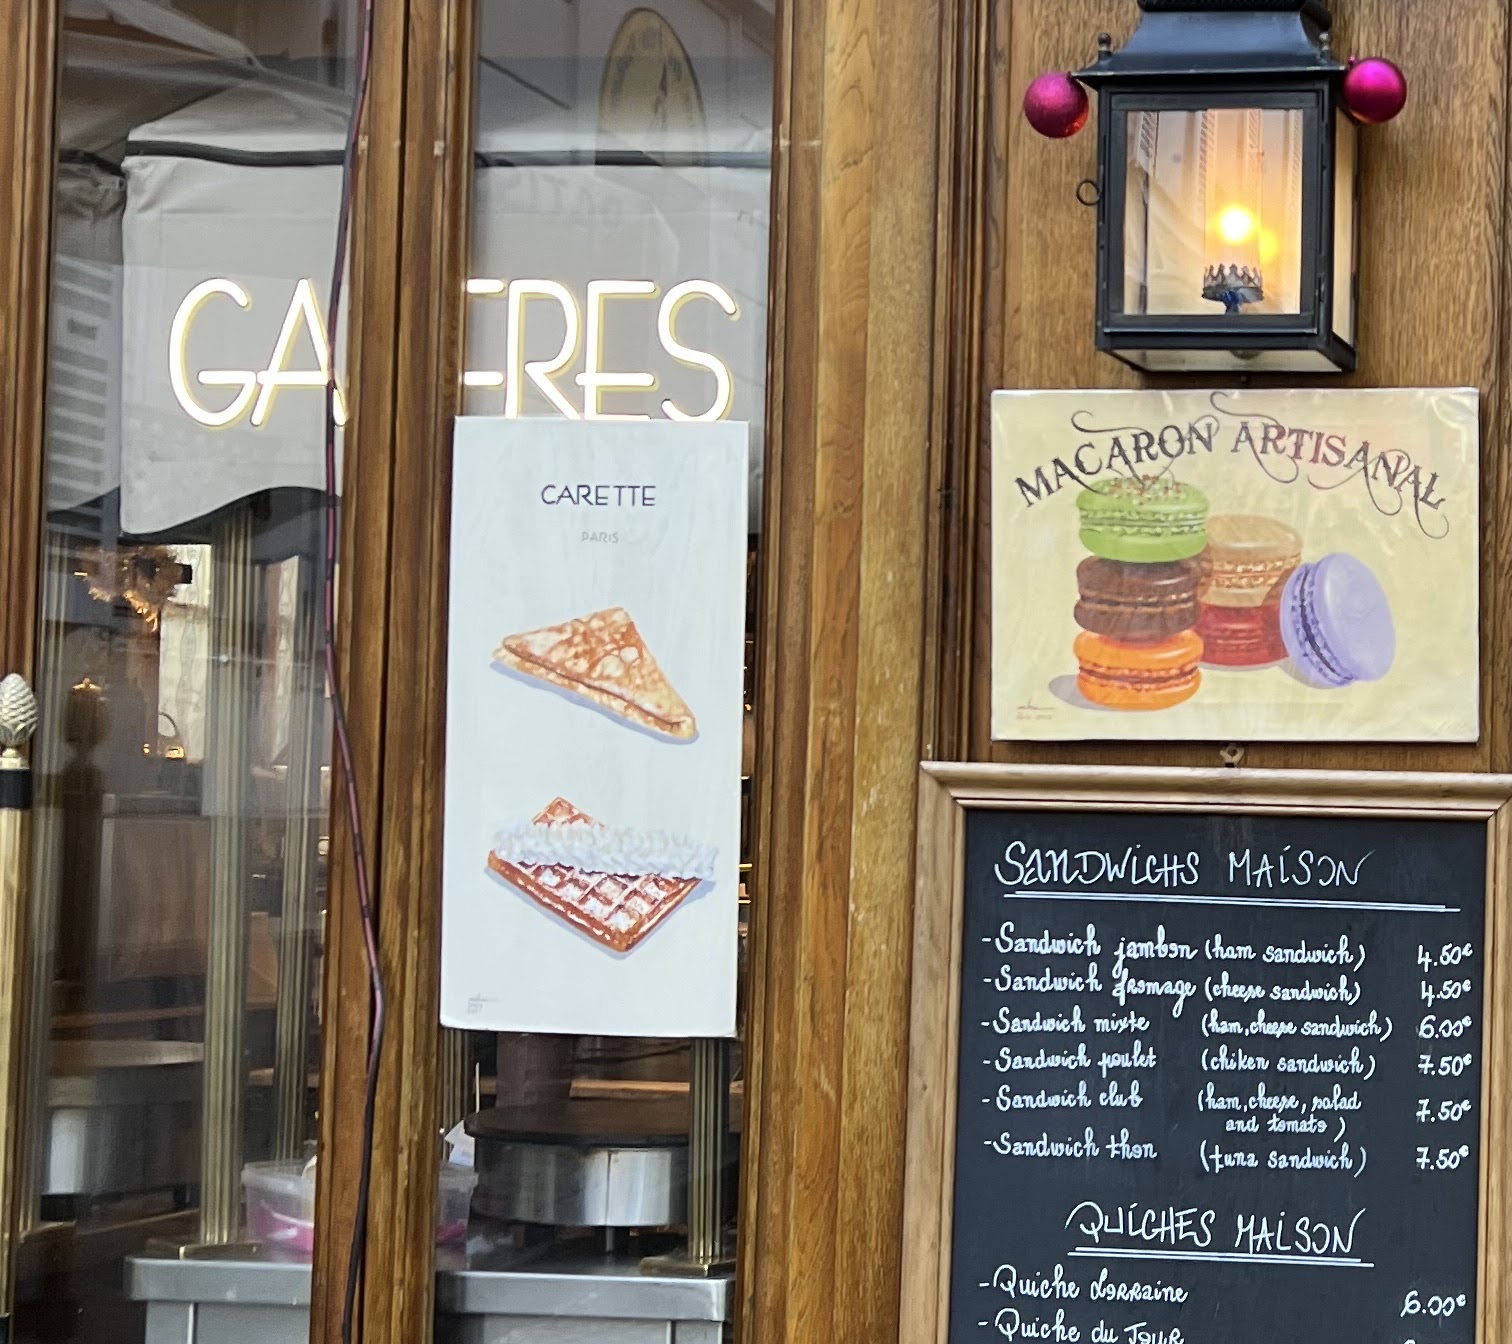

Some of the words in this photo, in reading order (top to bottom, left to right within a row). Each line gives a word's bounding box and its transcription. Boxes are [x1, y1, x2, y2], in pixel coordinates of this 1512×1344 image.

[1014, 409, 1220, 508] MACARON
[1210, 391, 1449, 540] ARTISANAL
[541, 484, 656, 507] CARETTE
[581, 531, 620, 544] PARIS
[994, 840, 1200, 888] SANDWICHS
[1229, 844, 1377, 888] MAISON
[1112, 924, 1198, 978] jambon
[1112, 967, 1197, 1018] fromage
[1094, 1010, 1150, 1033] mixte
[1098, 1039, 1157, 1078] poulet
[1099, 1079, 1144, 1108] club
[1311, 1083, 1362, 1112] salad
[1225, 1116, 1260, 1134] and
[1105, 1128, 1158, 1160] thon
[1065, 1201, 1216, 1247] QUICHES
[1234, 1208, 1367, 1255] MAISON
[1091, 1319, 1119, 1344] du
